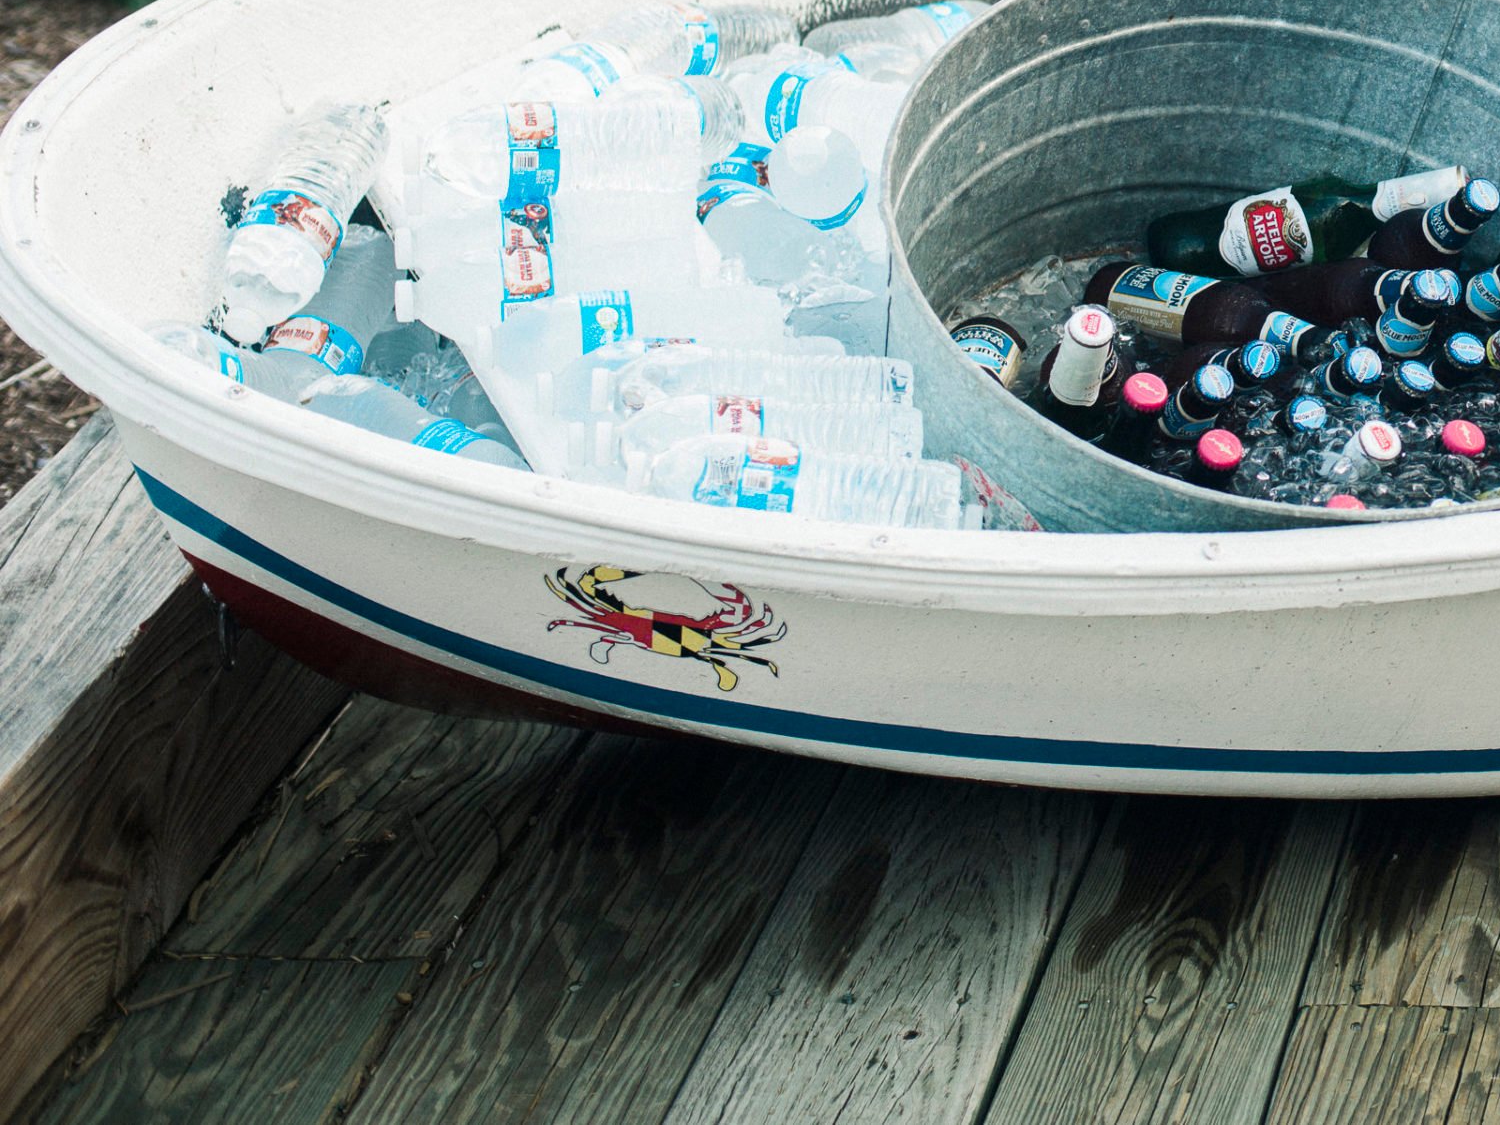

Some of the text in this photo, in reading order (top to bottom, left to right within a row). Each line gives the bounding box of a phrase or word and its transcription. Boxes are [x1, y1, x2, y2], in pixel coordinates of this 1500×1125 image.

[1252, 214, 1277, 266] ARTOIS
[1265, 210, 1288, 263] STELLA
[1169, 278, 1189, 308] MOON
[1474, 275, 1488, 295] BLUE
[1382, 325, 1427, 342] BLUE MOON
